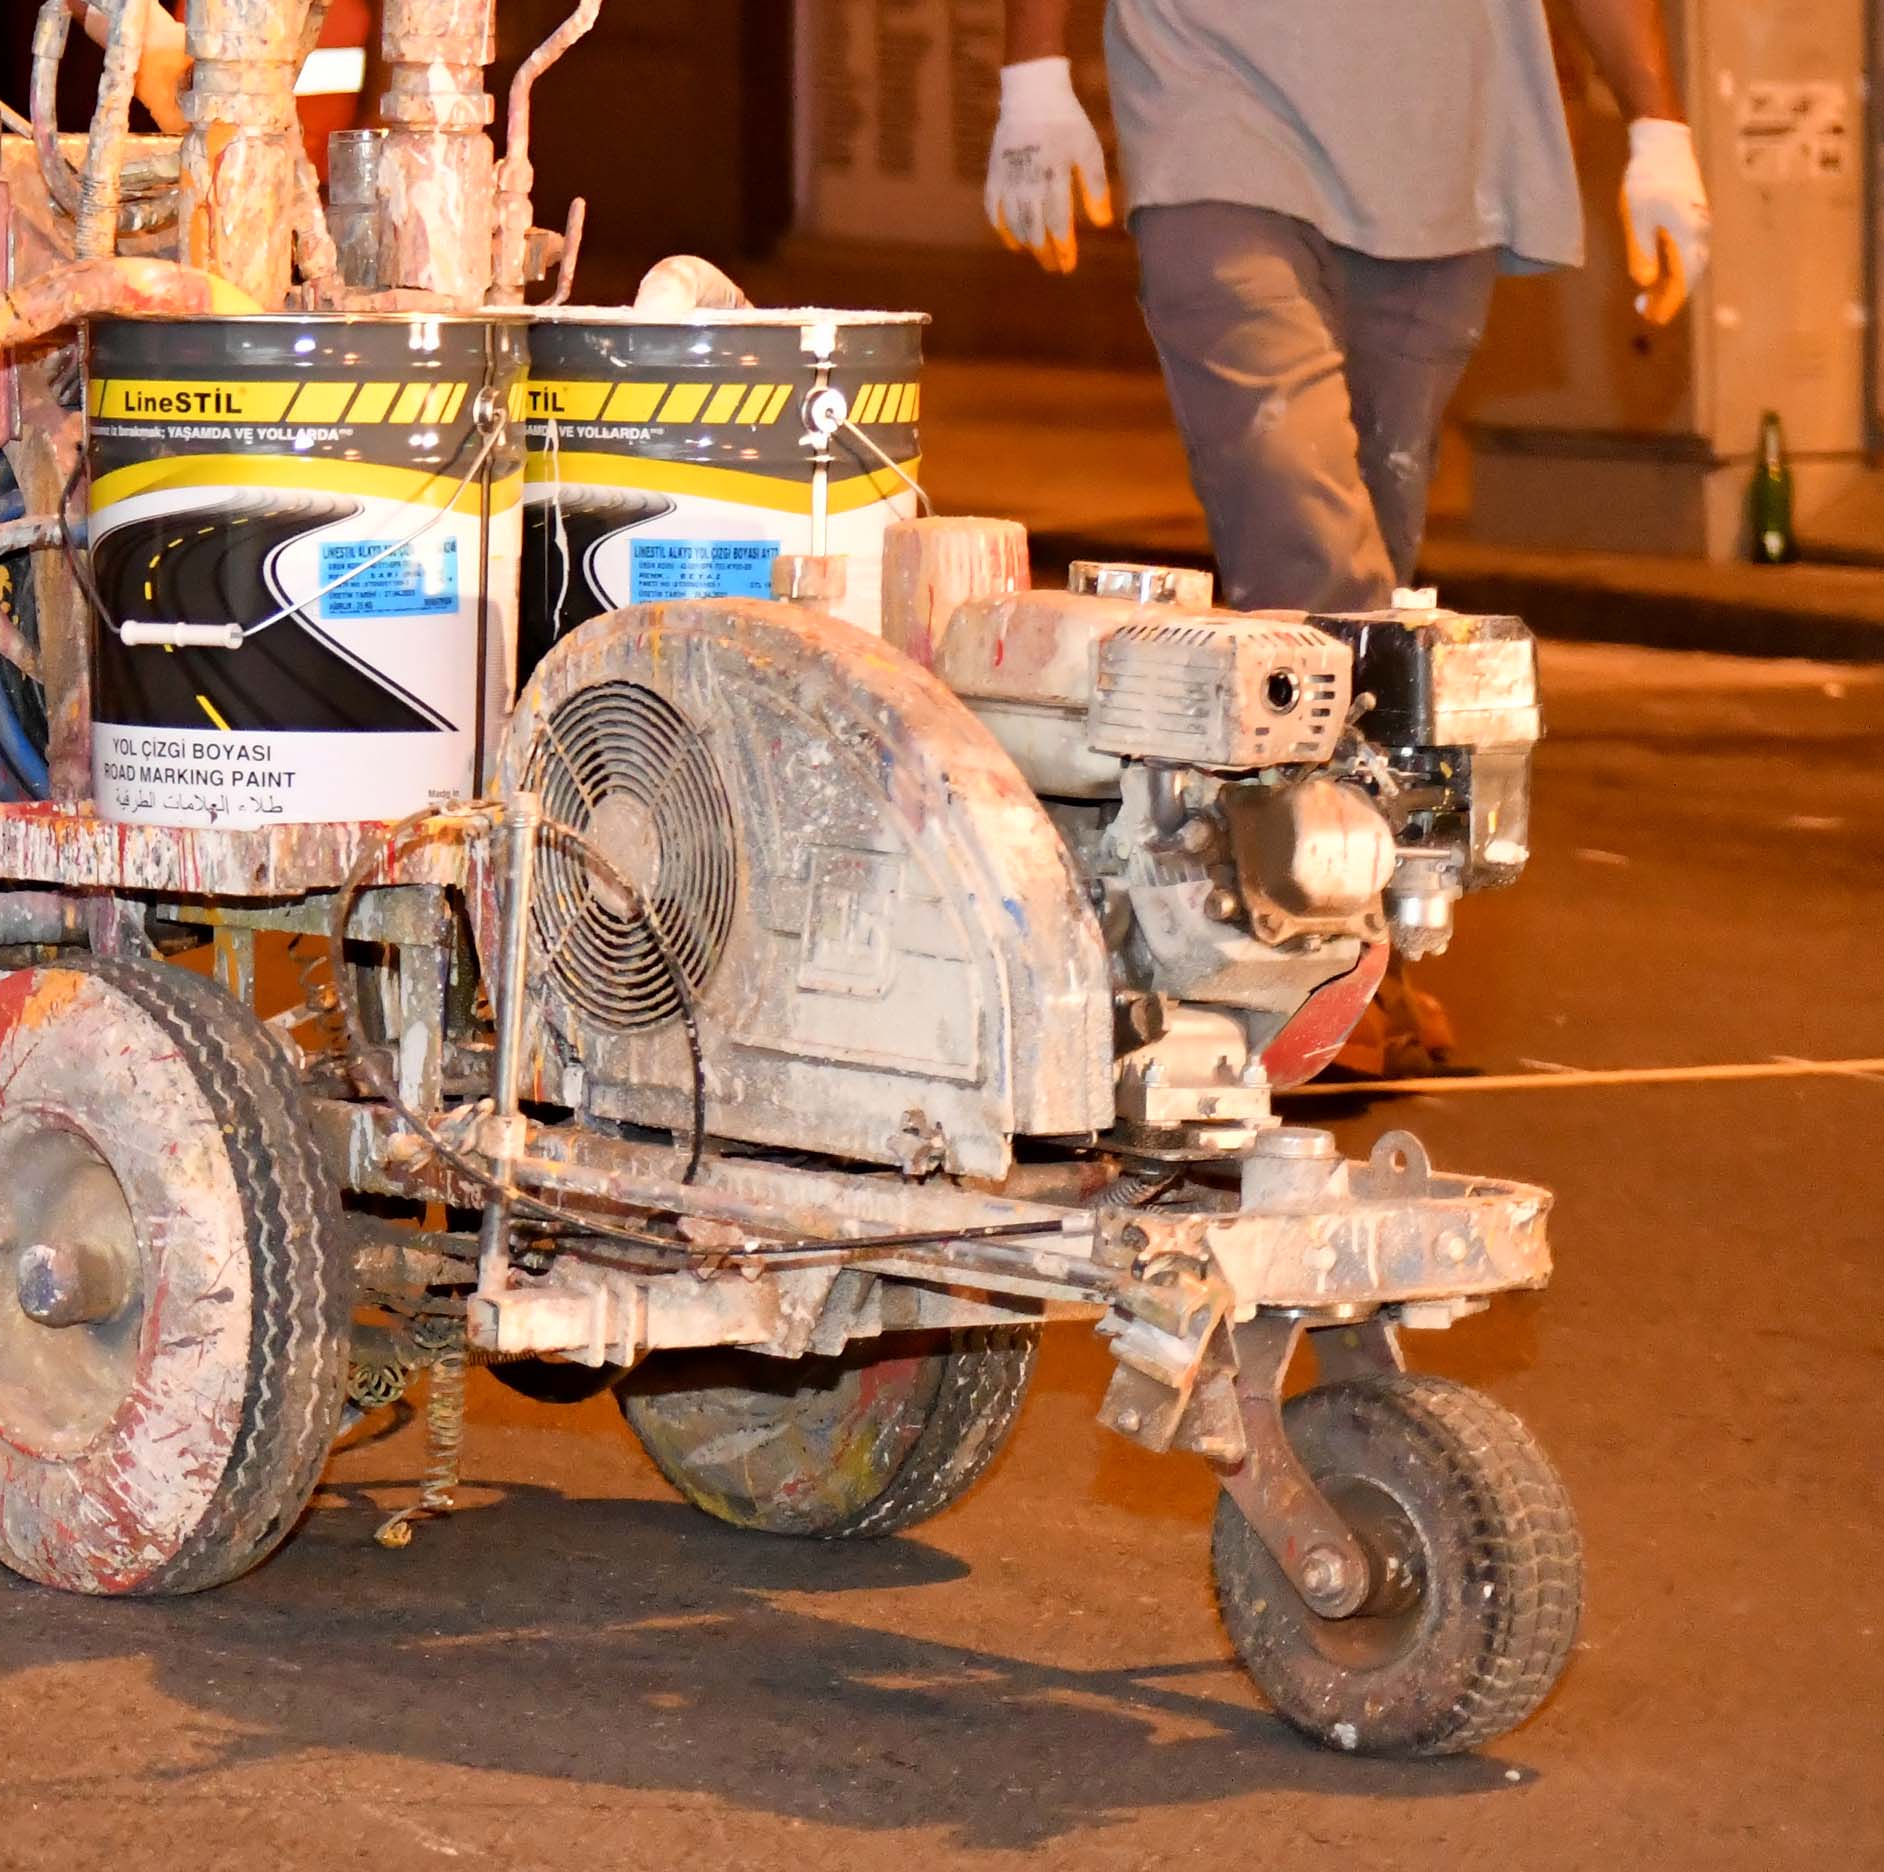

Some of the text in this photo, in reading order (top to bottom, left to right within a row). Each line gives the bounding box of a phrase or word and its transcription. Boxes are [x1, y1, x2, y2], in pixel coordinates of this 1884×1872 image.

[123, 387, 242, 415] LineSTİL
[167, 425, 231, 442] YAŞAMDA
[234, 427, 254, 440] VE
[257, 427, 340, 441] YOLLARDA
[559, 425, 575, 438] VE
[576, 426, 651, 440] YOLLARDA
[112, 736, 272, 762] YOL ÇİZGİ BOYASI
[104, 761, 297, 789] ROAD MARKING PAINT
